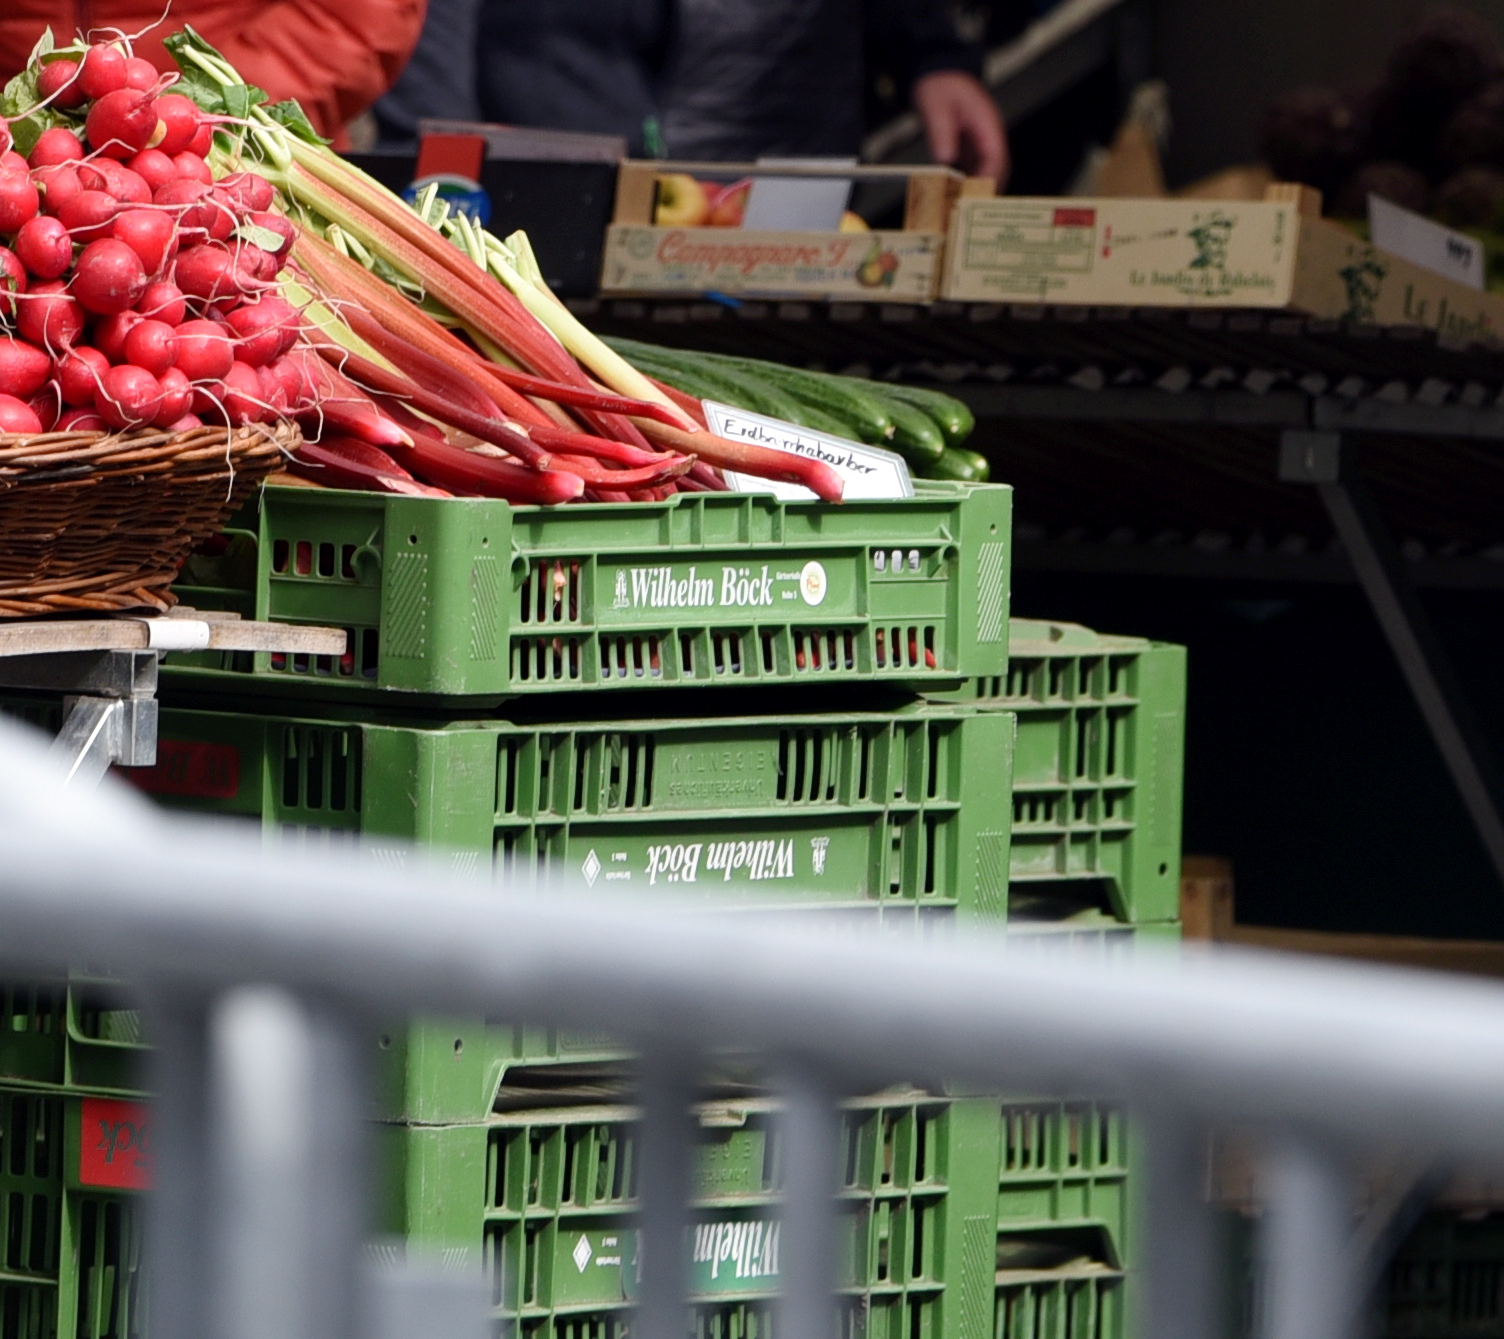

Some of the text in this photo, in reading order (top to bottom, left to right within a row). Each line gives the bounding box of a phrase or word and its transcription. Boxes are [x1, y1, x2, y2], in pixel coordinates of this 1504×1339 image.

[630, 564, 774, 609] Wilhelm Böck
[644, 838, 795, 886] Wilhelm Böck
[693, 1220, 781, 1280] Wilhelm
